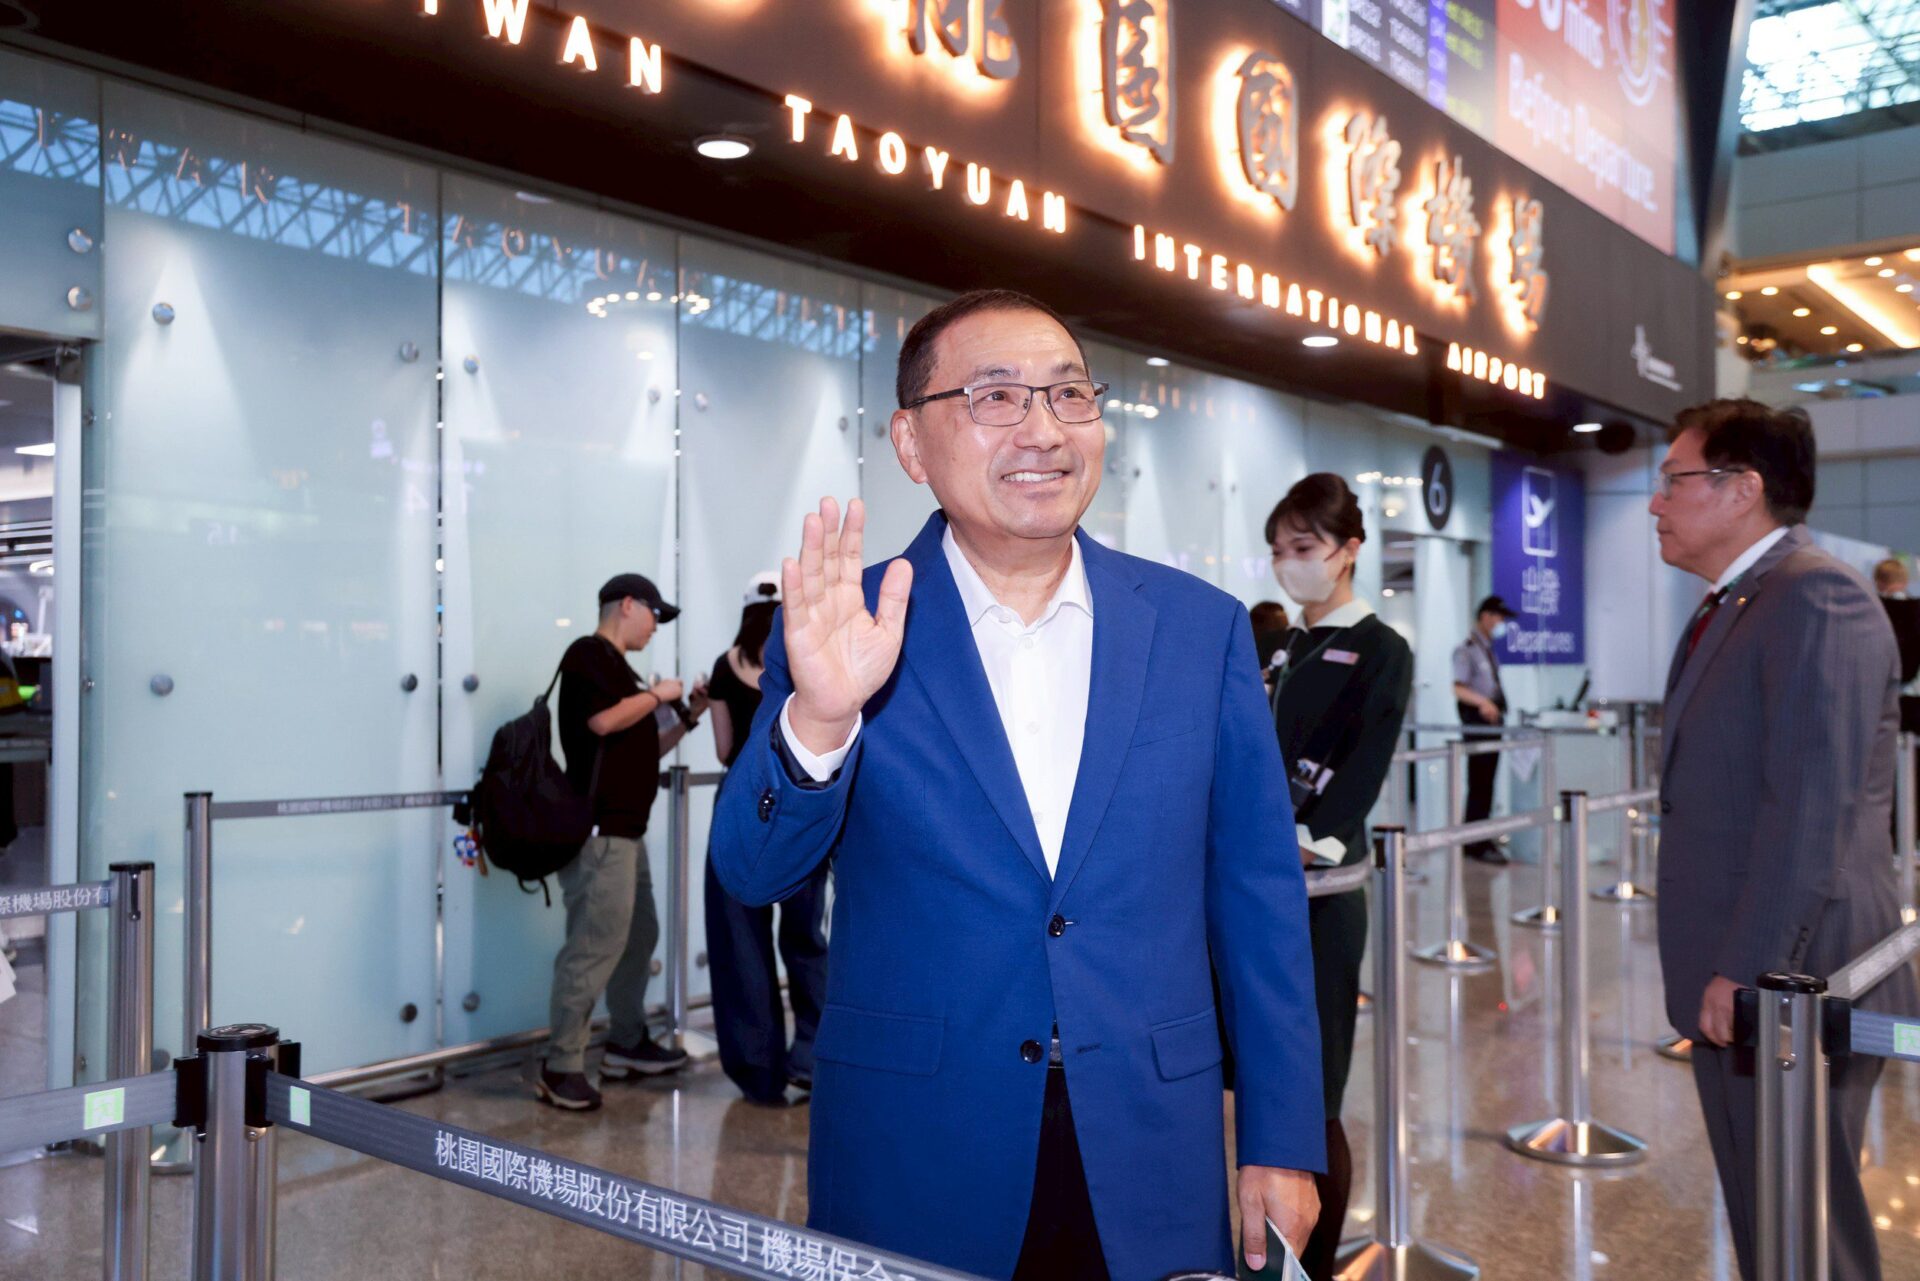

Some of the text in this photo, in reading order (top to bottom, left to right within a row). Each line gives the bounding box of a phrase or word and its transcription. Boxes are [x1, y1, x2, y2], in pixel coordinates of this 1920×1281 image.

[1509, 52, 1571, 155] Before
[785, 94, 1066, 233] TAOYUAN
[1133, 224, 1419, 356] INTERNATIONAL
[1447, 342, 1546, 399] AIRPORT
[1428, 463, 1448, 517] 6
[1507, 621, 1576, 661] Departures
[434, 1129, 750, 1264] 桃園國際機場股份有限公司
